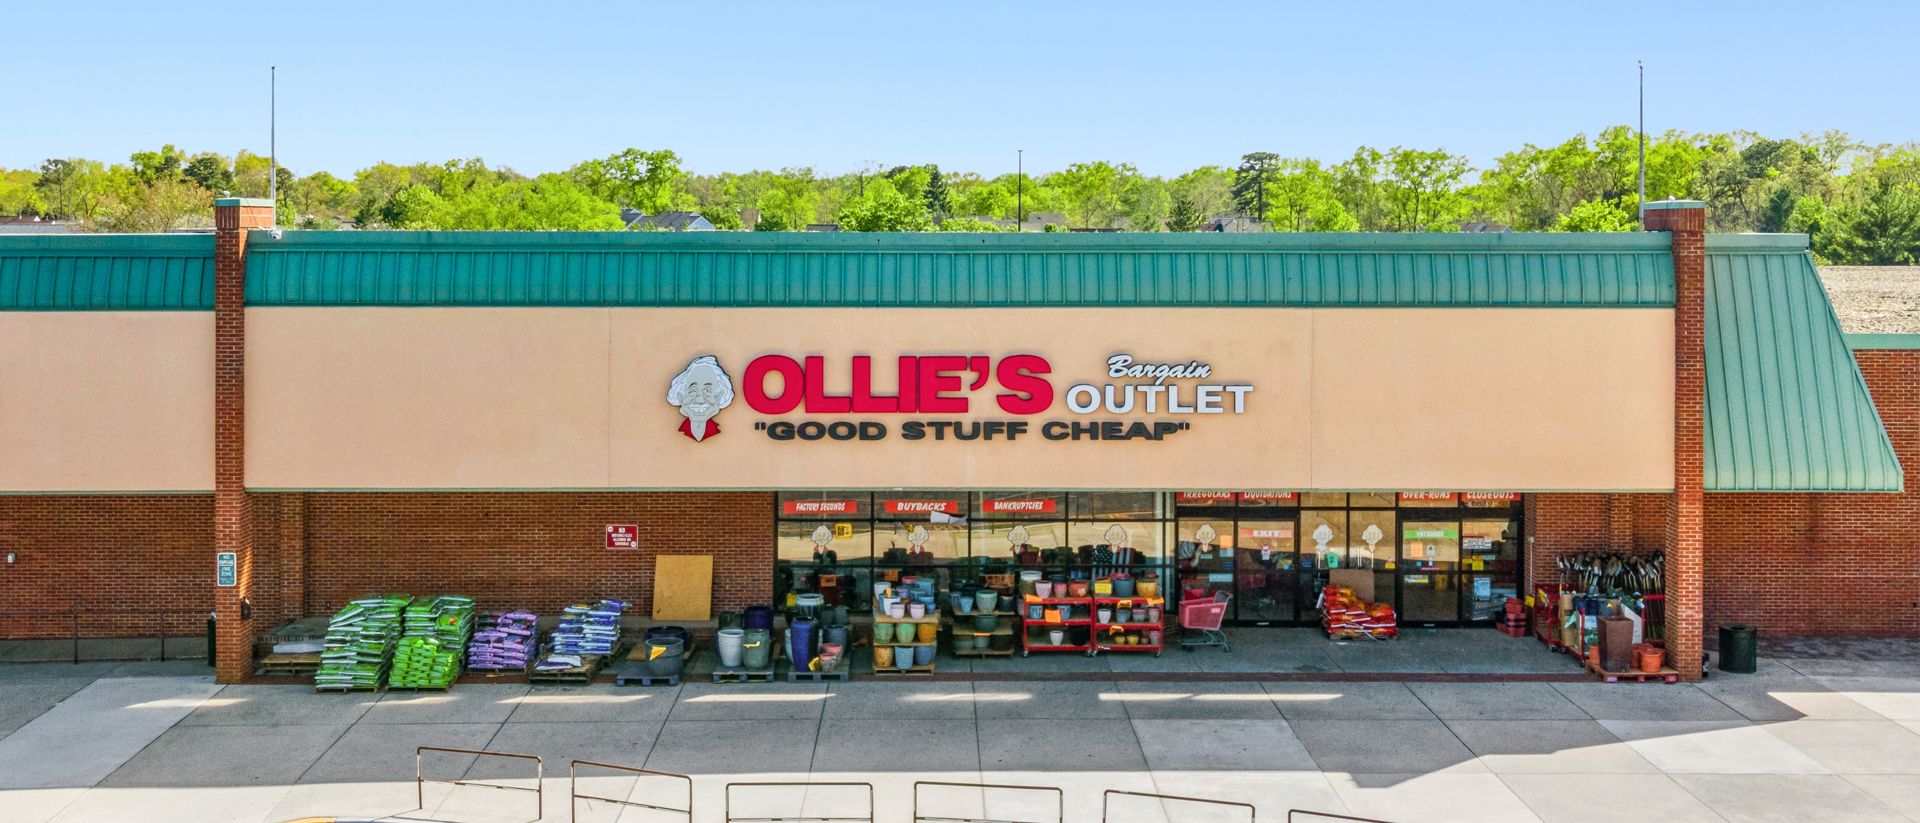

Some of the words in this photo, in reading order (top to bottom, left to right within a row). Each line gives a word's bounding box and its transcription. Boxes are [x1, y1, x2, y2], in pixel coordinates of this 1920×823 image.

[1106, 353, 1212, 386] Bargain
[743, 354, 1054, 415] OLLIE'S
[1066, 384, 1254, 415] OUTLET
[754, 421, 888, 441] "GOOD
[900, 421, 1029, 441] STUFF
[1041, 421, 1191, 441] CHEAP"
[796, 503, 819, 511] FACTORY
[820, 503, 846, 511] SECONDS
[897, 502, 947, 511] BUYBACKS
[994, 501, 1043, 510] BANKRUPTCIES
